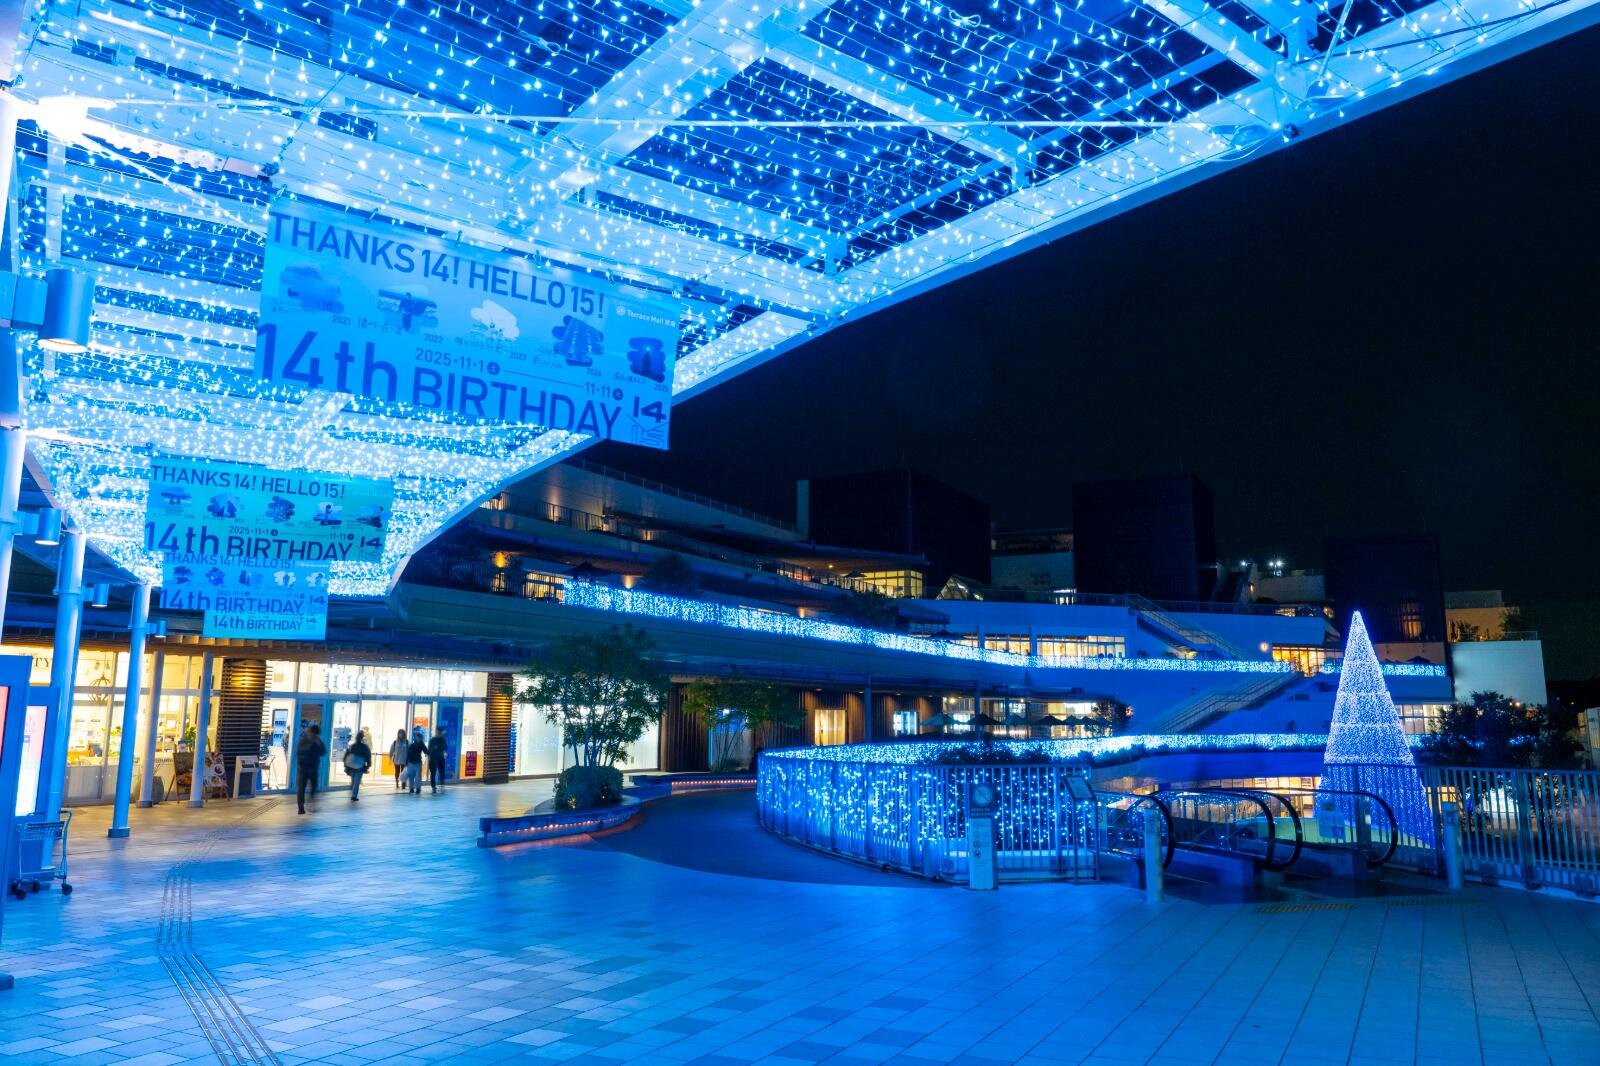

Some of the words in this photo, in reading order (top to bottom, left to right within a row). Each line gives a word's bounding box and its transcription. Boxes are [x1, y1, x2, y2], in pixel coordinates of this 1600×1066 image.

[269, 211, 415, 275] THANKS
[421, 249, 460, 286] 14!
[468, 263, 567, 309] HELLO
[570, 286, 606, 319] 15!
[332, 314, 351, 326] 2021
[509, 351, 528, 362] 2023
[254, 322, 399, 401] 14th
[411, 366, 622, 440] BIRTHDAY
[152, 465, 231, 488] THANKS
[234, 473, 257, 491] 14!
[261, 477, 321, 497] HELLO
[323, 482, 346, 499] 15!
[144, 521, 220, 556] 14th
[227, 535, 352, 561] BIRTHDAY
[164, 552, 218, 566] THANKS
[160, 588, 210, 610] 14th
[215, 595, 304, 614] BIRTHDAY
[213, 614, 244, 630] 14th
[246, 618, 303, 631] BIRTHDAY
[324, 667, 397, 691] Terrace
